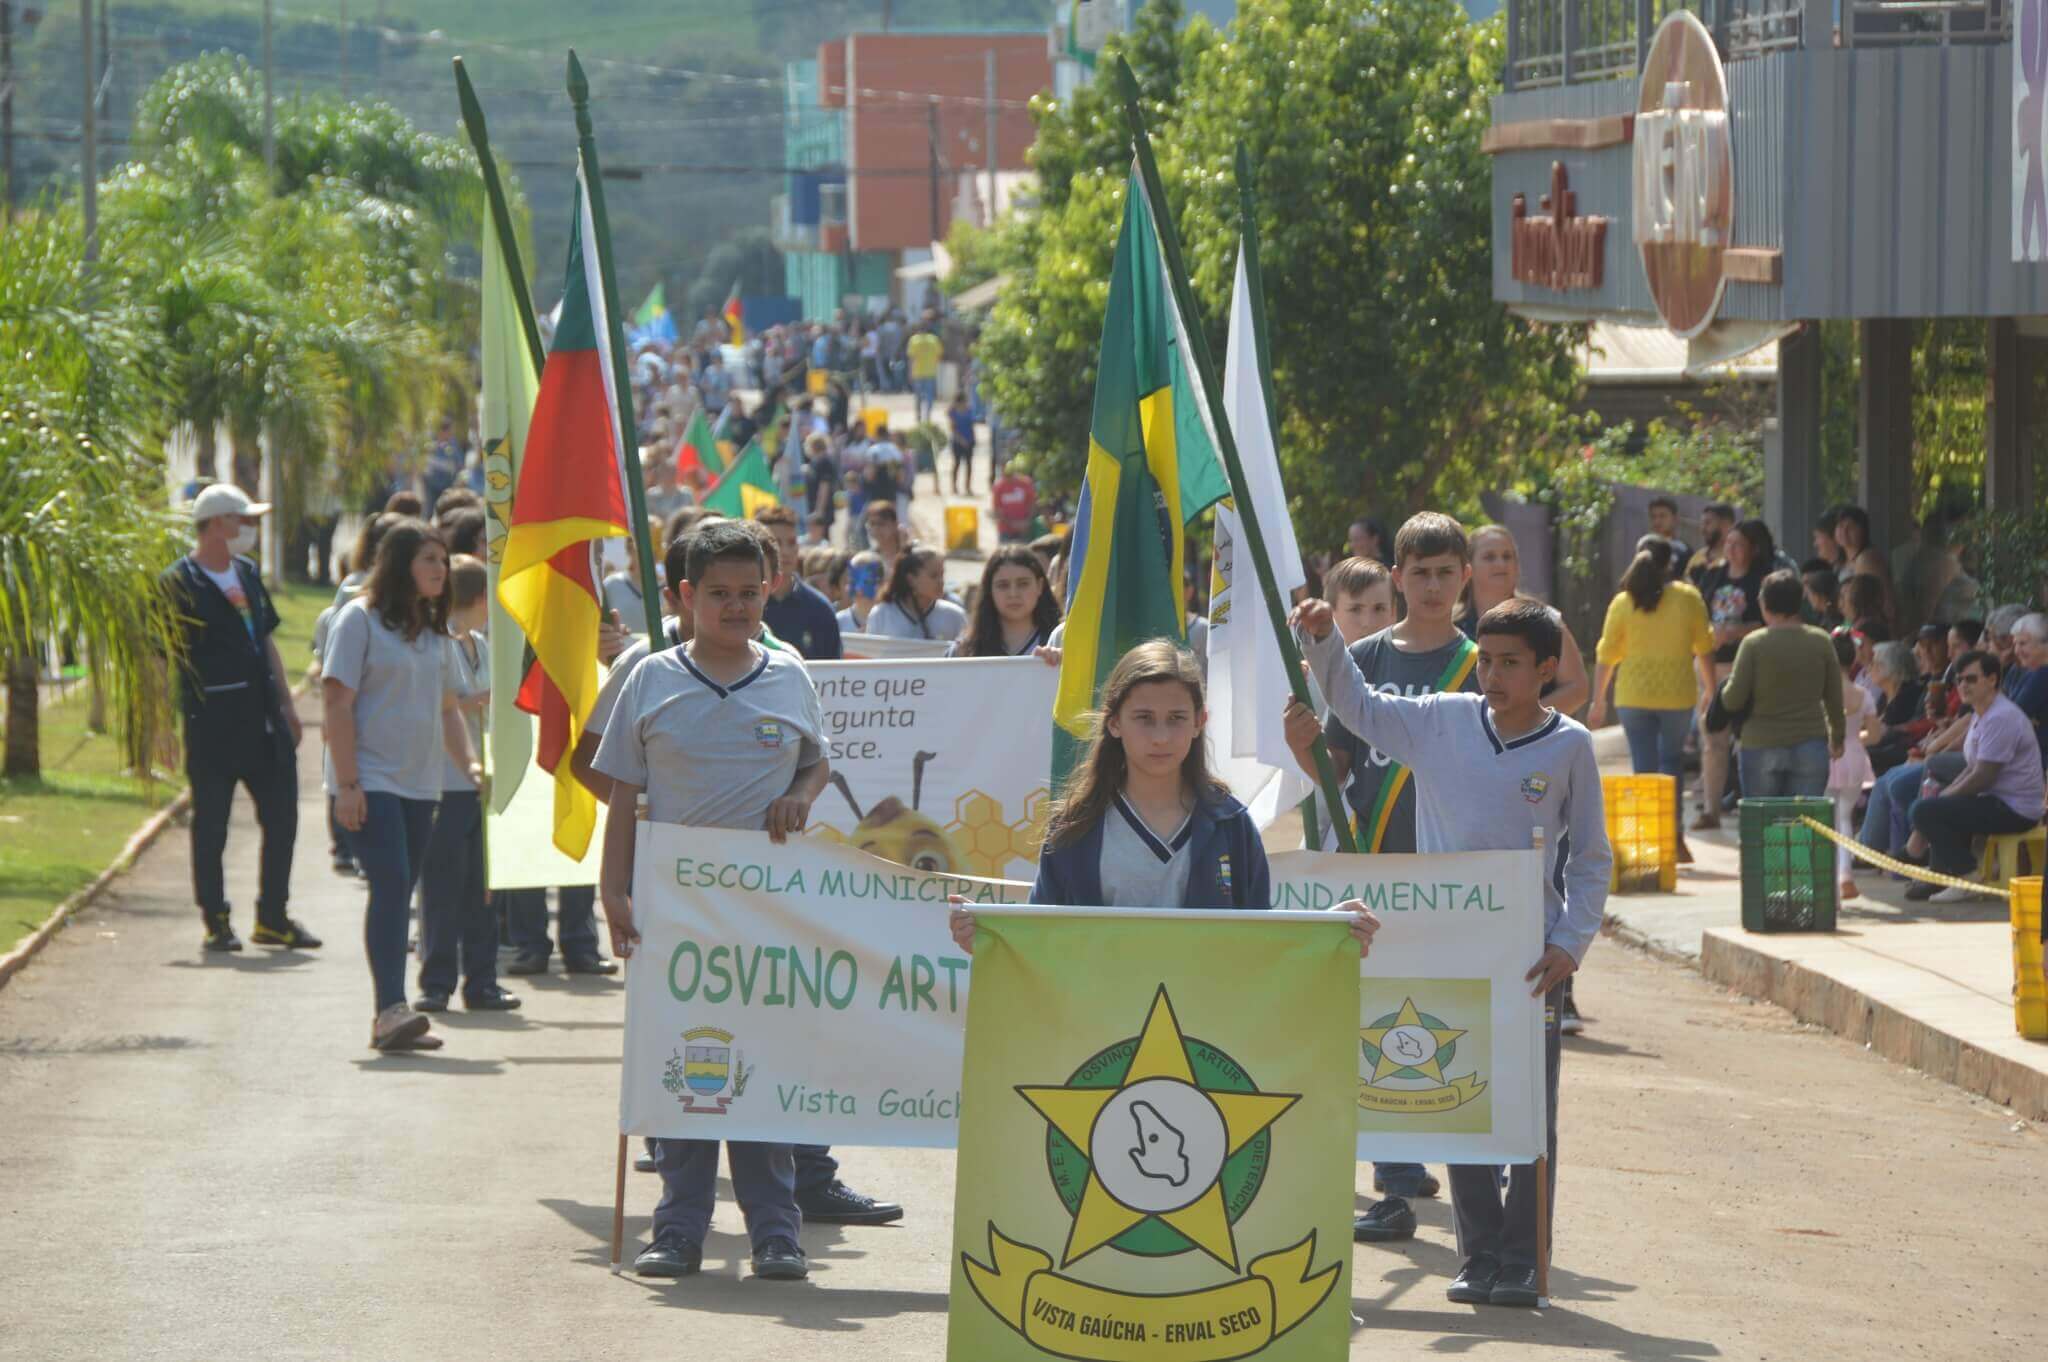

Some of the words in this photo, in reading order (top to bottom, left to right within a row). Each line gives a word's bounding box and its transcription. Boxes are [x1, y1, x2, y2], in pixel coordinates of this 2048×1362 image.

[874, 678, 926, 702] que
[676, 858, 806, 894] ESCOLA
[819, 870, 1016, 905] MUNICIPAL
[668, 940, 858, 1010] OSVINO
[879, 954, 968, 1012] ART
[1081, 1045, 1133, 1081] OSVINO
[1196, 1047, 1242, 1085] ARTUR
[777, 1084, 856, 1115] Vista
[1032, 1297, 1075, 1331] VISTA
[1079, 1313, 1146, 1342] GAÚCHA
[1165, 1320, 1216, 1343] ERVAL
[1220, 1306, 1262, 1336] SECO
